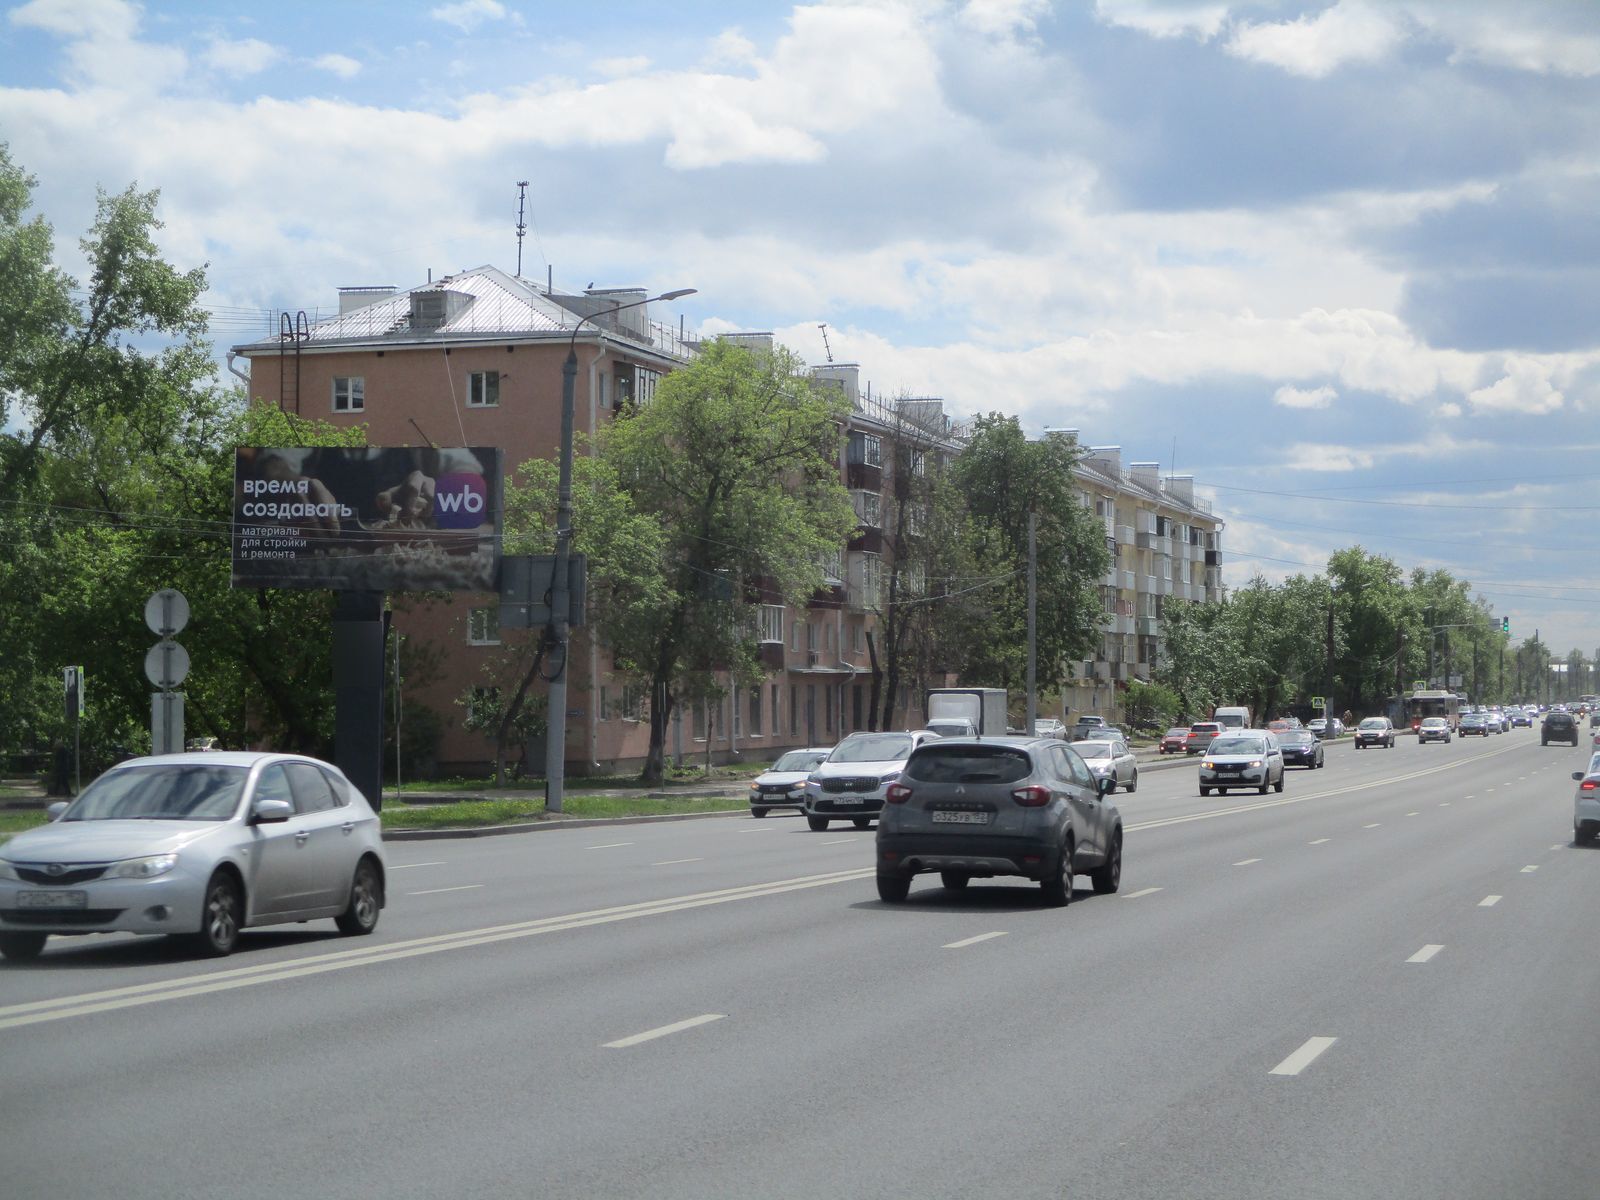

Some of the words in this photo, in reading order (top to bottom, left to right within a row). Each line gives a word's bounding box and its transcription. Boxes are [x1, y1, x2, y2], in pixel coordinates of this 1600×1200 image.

[243, 479, 309, 498] время
[437, 484, 483, 513] wb
[242, 502, 353, 519] создавать
[241, 527, 300, 537] материалы
[241, 539, 263, 549] для
[264, 537, 307, 549] стройки
[241, 551, 248, 559] и
[250, 550, 296, 560] ремонта
